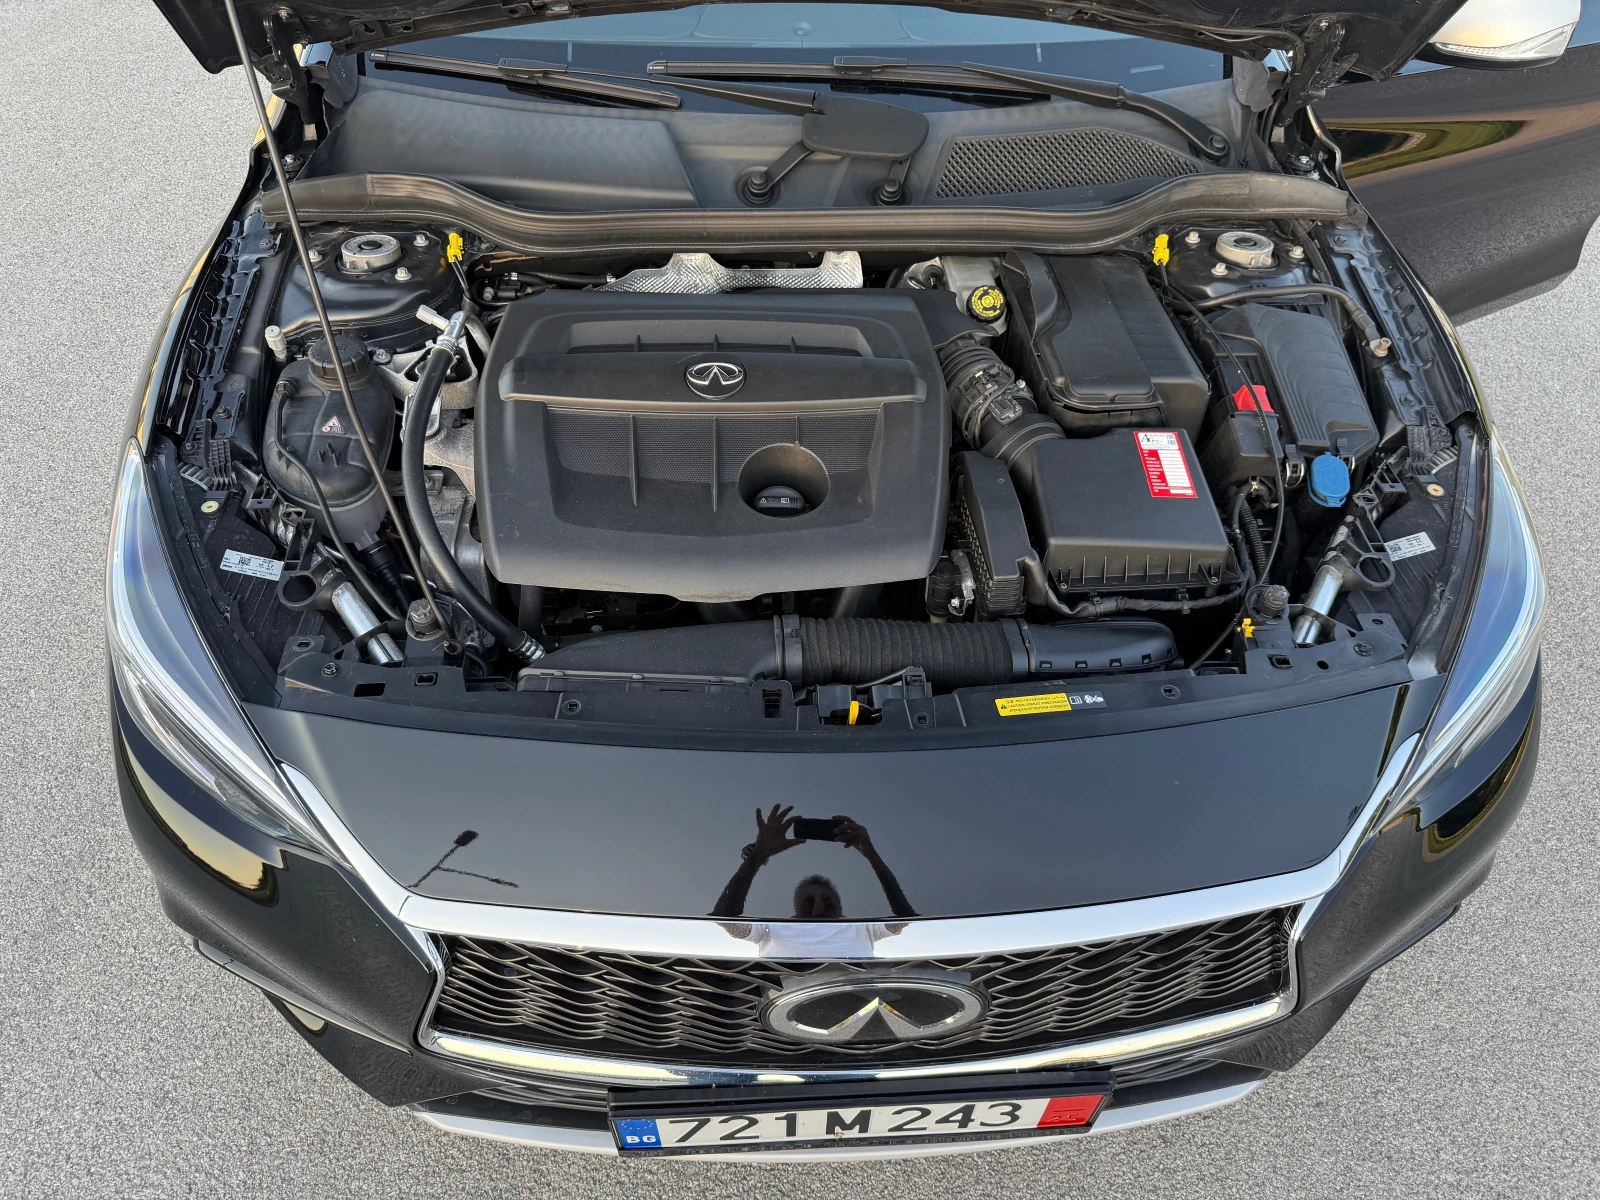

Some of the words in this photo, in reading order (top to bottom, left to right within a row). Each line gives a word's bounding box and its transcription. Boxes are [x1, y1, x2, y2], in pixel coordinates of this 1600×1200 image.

[669, 1113, 798, 1143] 721
[826, 1109, 872, 1135] M
[887, 1101, 1022, 1133] 243
[625, 1135, 657, 1144] BG
